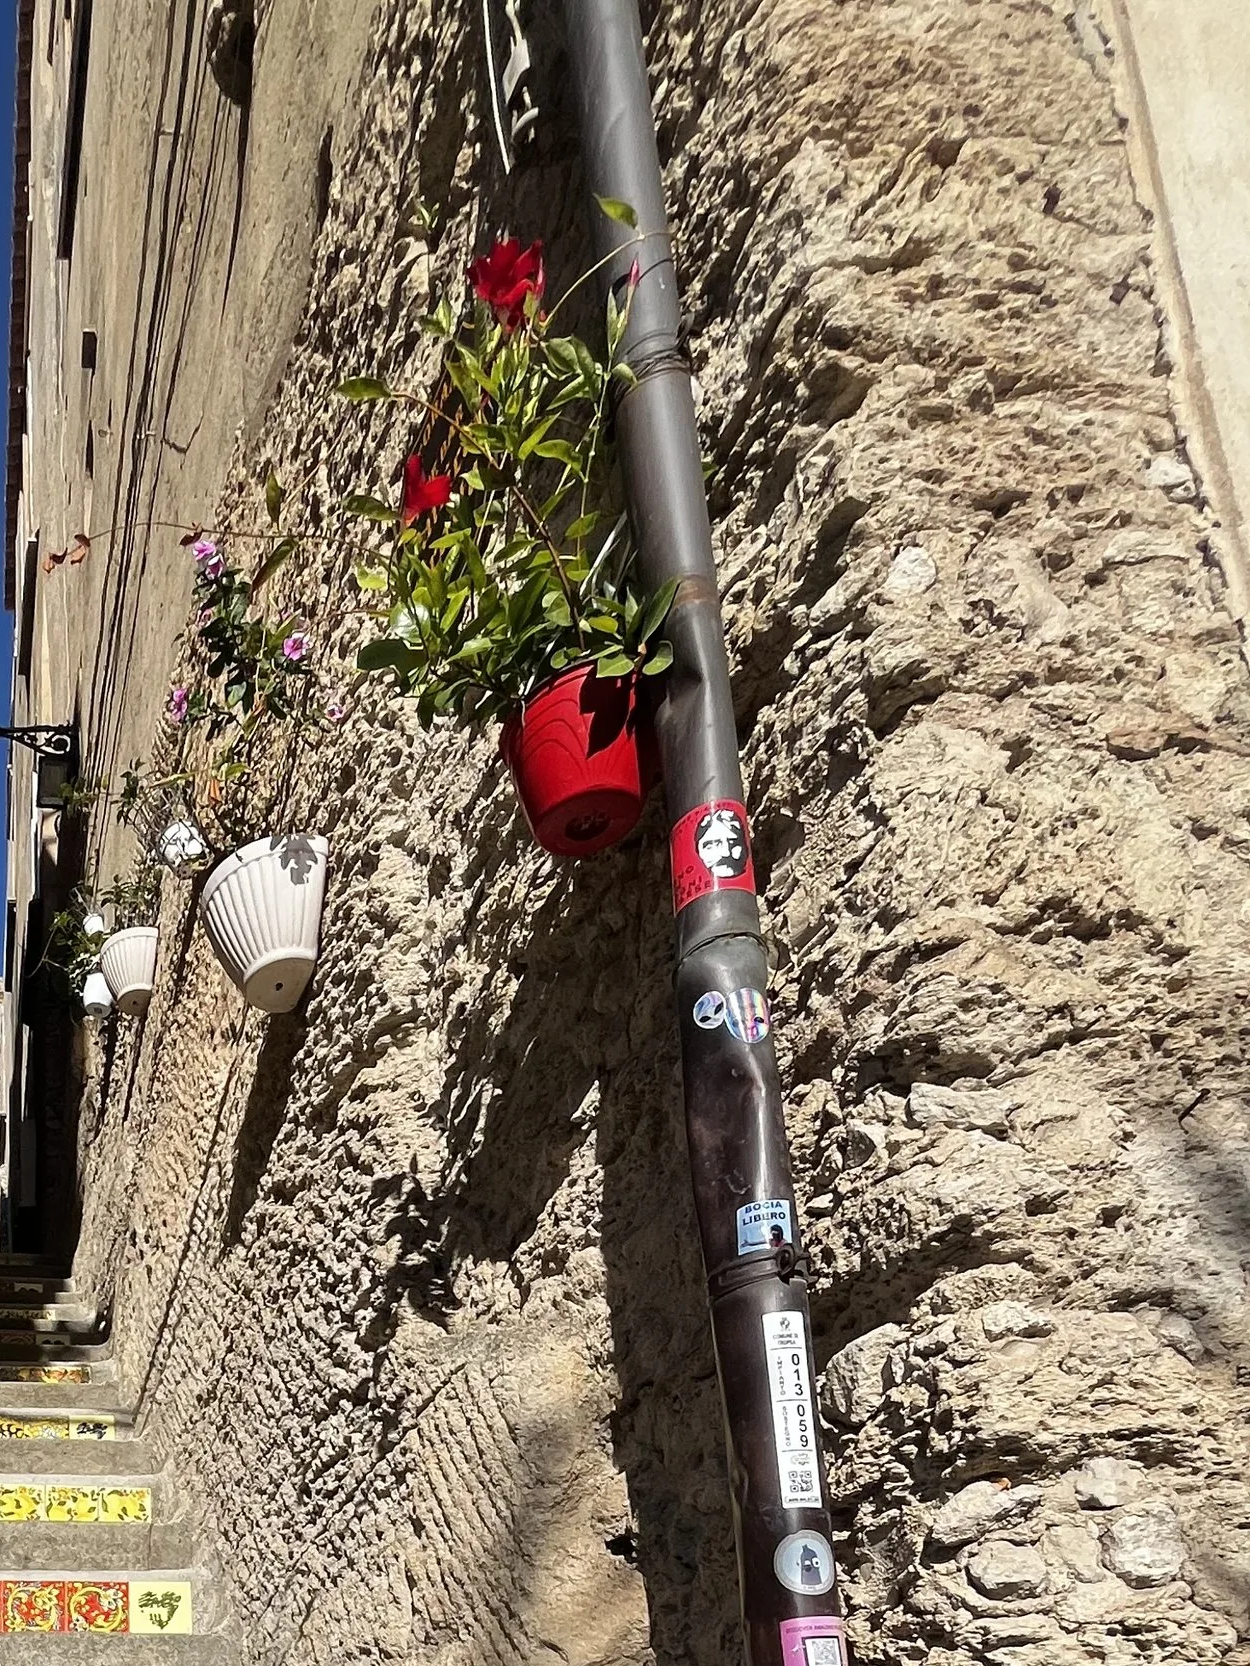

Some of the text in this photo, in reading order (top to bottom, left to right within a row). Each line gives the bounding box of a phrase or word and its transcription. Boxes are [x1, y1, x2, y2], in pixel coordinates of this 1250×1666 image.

[742, 1211, 786, 1226] LIBERO
[744, 1200, 783, 1214] BOCIA
[791, 1353, 804, 1396] 013
[796, 1404, 809, 1448] 059
